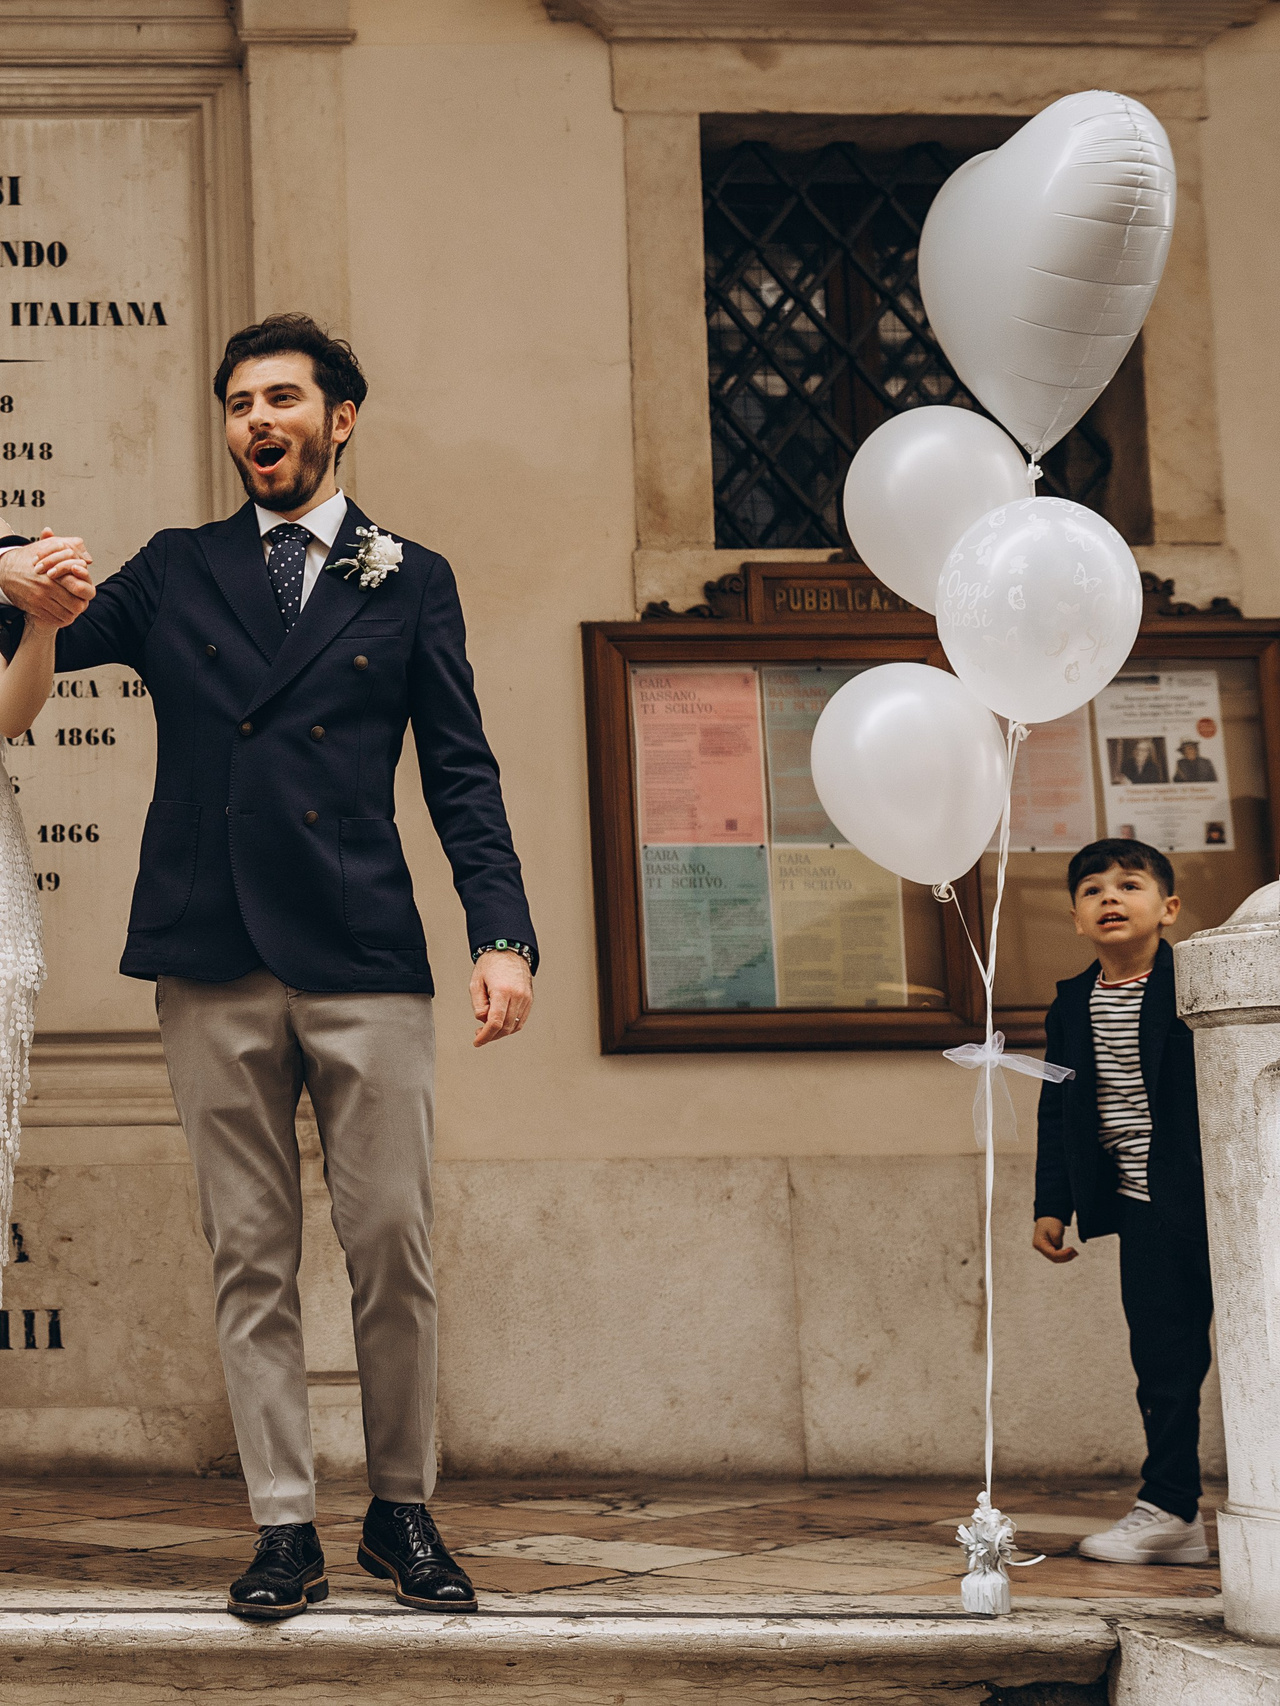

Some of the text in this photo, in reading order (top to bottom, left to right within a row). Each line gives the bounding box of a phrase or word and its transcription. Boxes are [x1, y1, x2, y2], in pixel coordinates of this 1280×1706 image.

[10, 301, 169, 327] ITALIANA
[946, 569, 995, 609] Oggi
[638, 678, 672, 689] CARA
[54, 727, 116, 747] 1866
[36, 823, 100, 844] 1866
[645, 850, 679, 861] CARA
